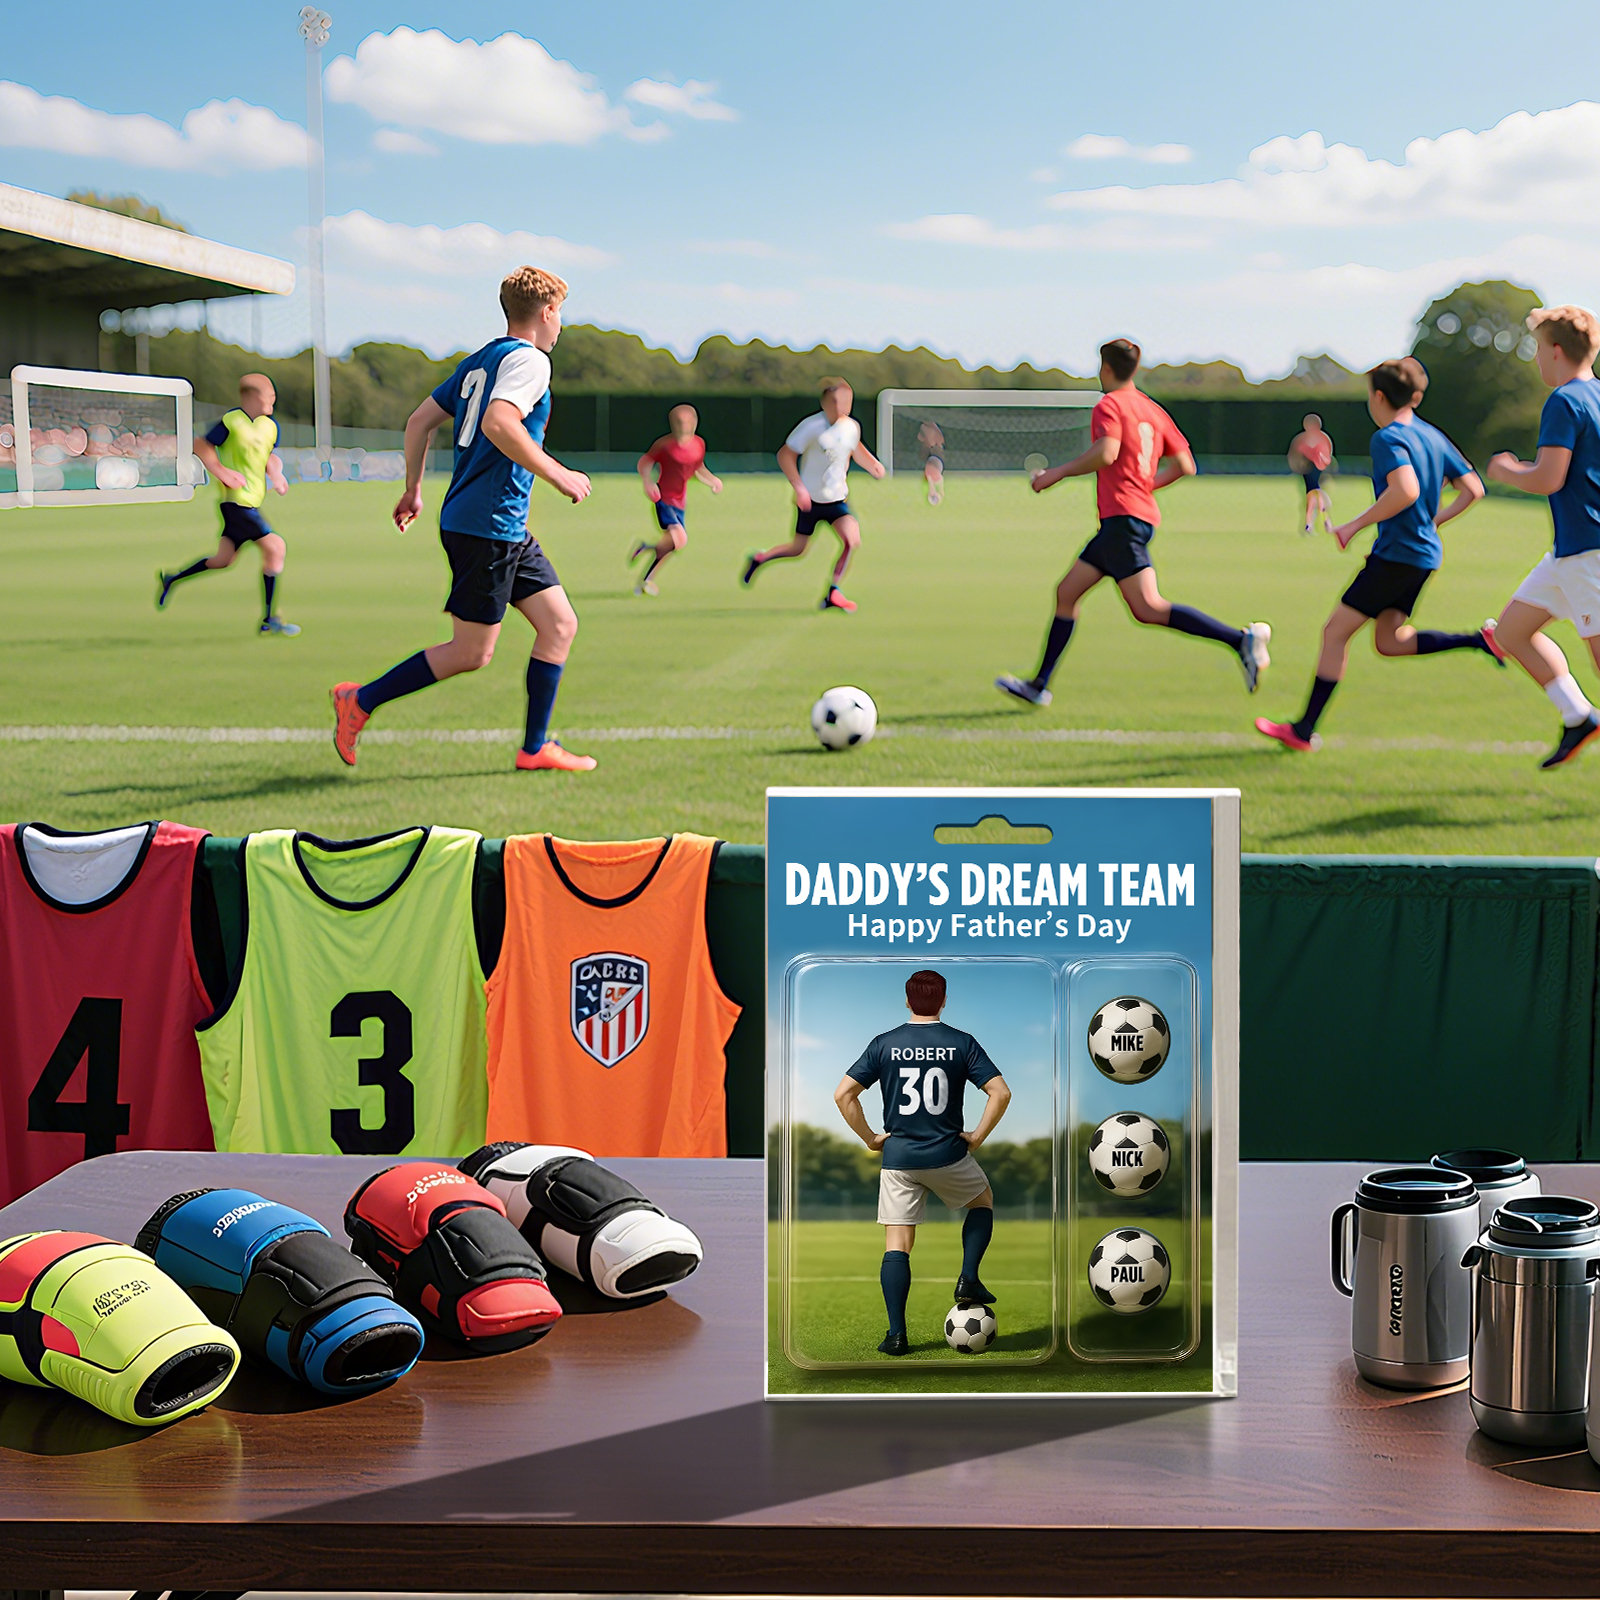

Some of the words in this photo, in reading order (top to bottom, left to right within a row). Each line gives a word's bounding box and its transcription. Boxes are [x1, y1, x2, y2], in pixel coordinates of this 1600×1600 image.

[785, 862, 950, 906] DADDY'S
[961, 863, 1086, 906] DREAM
[1099, 863, 1195, 906] TEAM
[848, 913, 942, 943] Happy
[951, 910, 1068, 937] Father's
[1078, 913, 1132, 943] Day
[891, 1047, 957, 1061] ROBERT
[1111, 1035, 1144, 1051] MIKE
[27, 996, 131, 1161] 4
[329, 990, 415, 1155] 3
[898, 1066, 949, 1116] 30
[1111, 1151, 1144, 1167] NICK
[1111, 1266, 1146, 1283] PAUL
